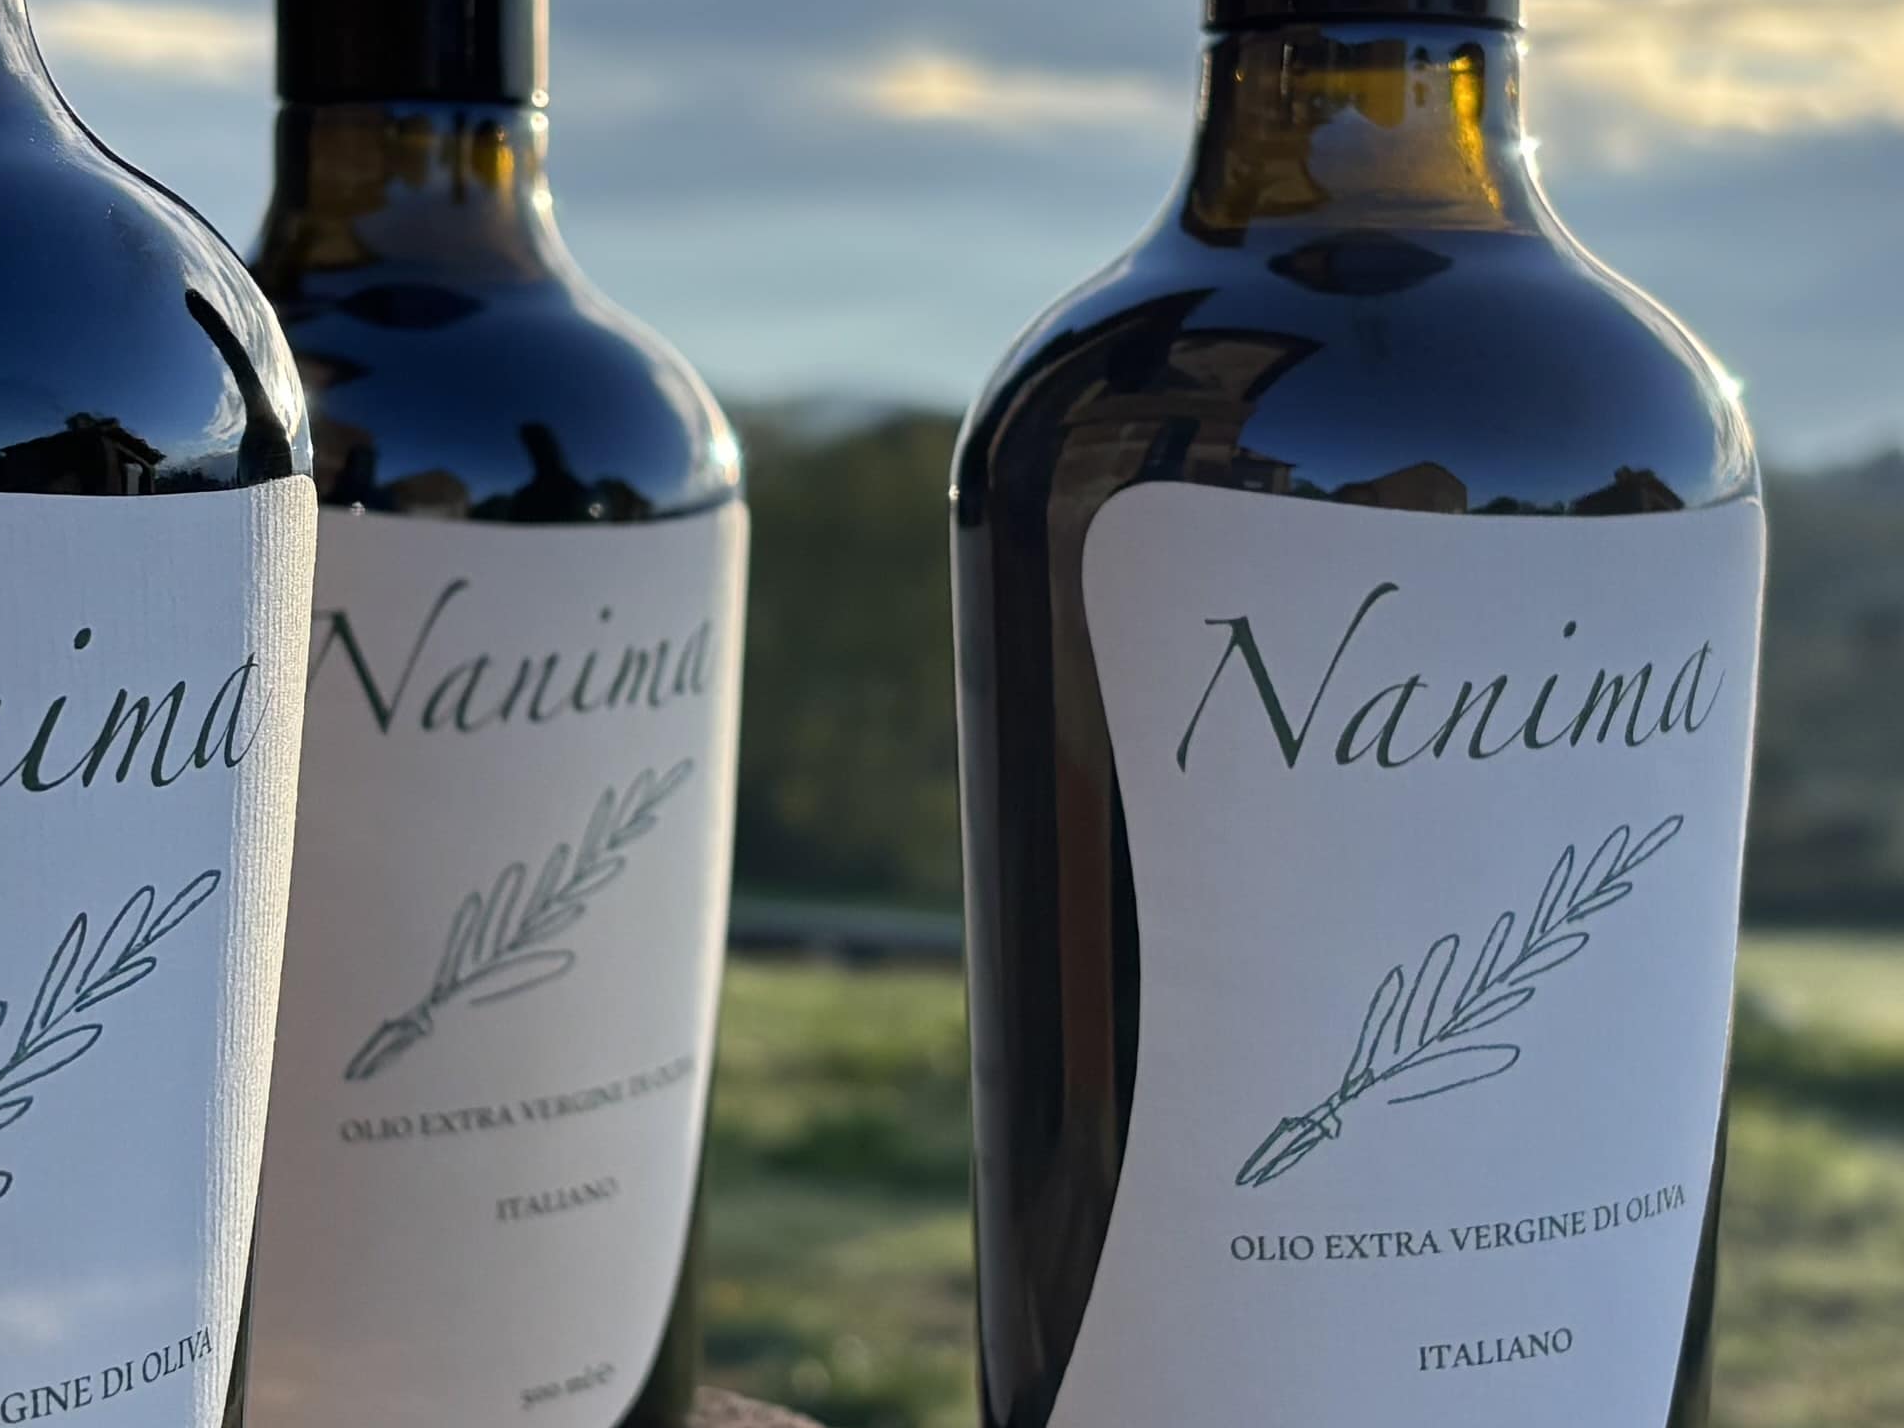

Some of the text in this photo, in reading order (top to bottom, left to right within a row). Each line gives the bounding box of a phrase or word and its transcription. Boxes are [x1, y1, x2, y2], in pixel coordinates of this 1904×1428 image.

[306, 577, 715, 736] Nanima
[1176, 581, 1724, 772] Nanima
[1230, 1183, 1687, 1261] OLIO EXTRA VERGINE DI OLIVA
[101, 1360, 135, 1401] DI
[142, 1326, 214, 1384] OLIVA
[1419, 1327, 1574, 1371] ITALIANO
